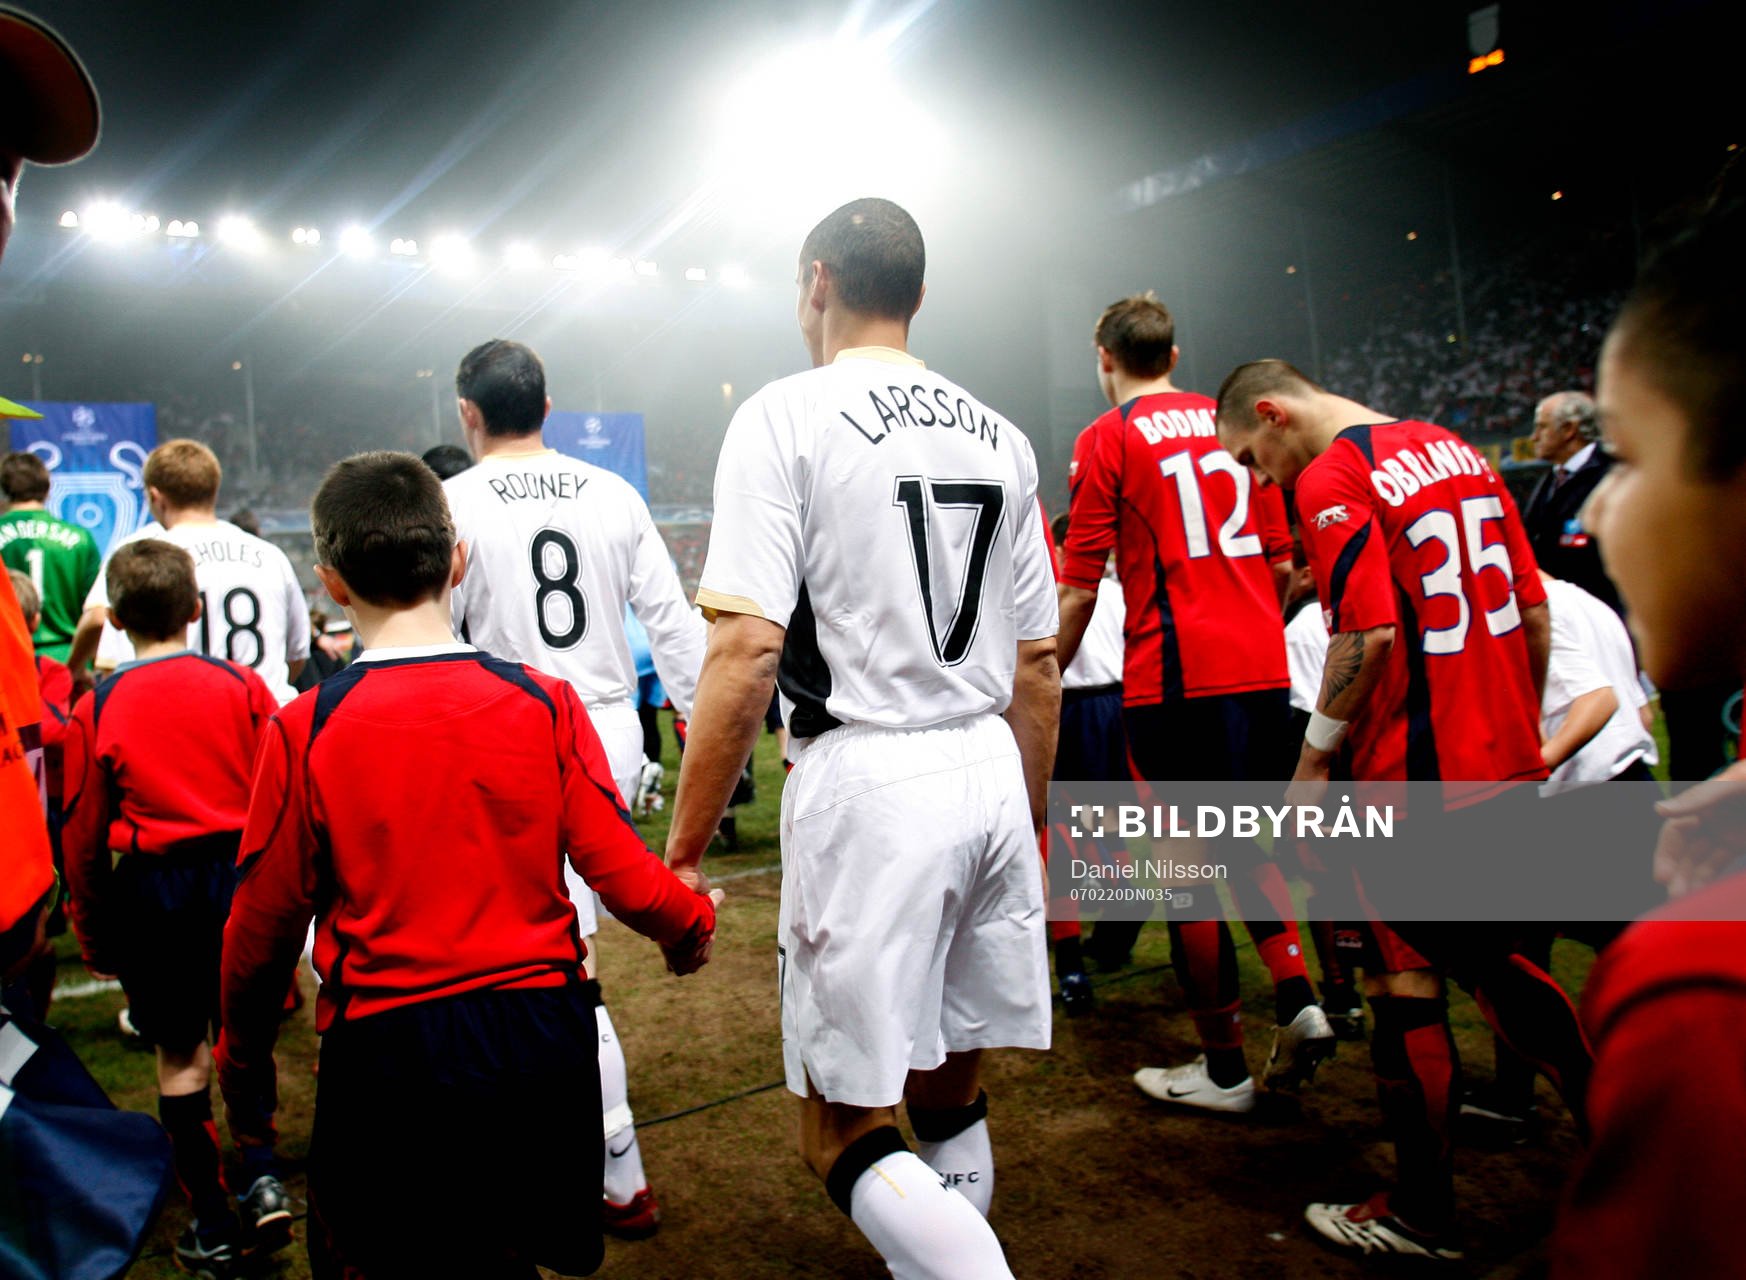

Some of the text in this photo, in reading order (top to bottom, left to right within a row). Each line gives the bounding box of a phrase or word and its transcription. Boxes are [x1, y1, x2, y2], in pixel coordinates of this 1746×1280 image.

[840, 385, 998, 451] LARSSON
[1133, 408, 1216, 445] BODM
[489, 473, 588, 504] ROONEY
[1158, 448, 1263, 559] 12
[196, 540, 264, 569] HOLES
[528, 525, 590, 652] 8
[892, 475, 1006, 667] 17
[1405, 494, 1522, 656] 35
[198, 587, 264, 668] 18
